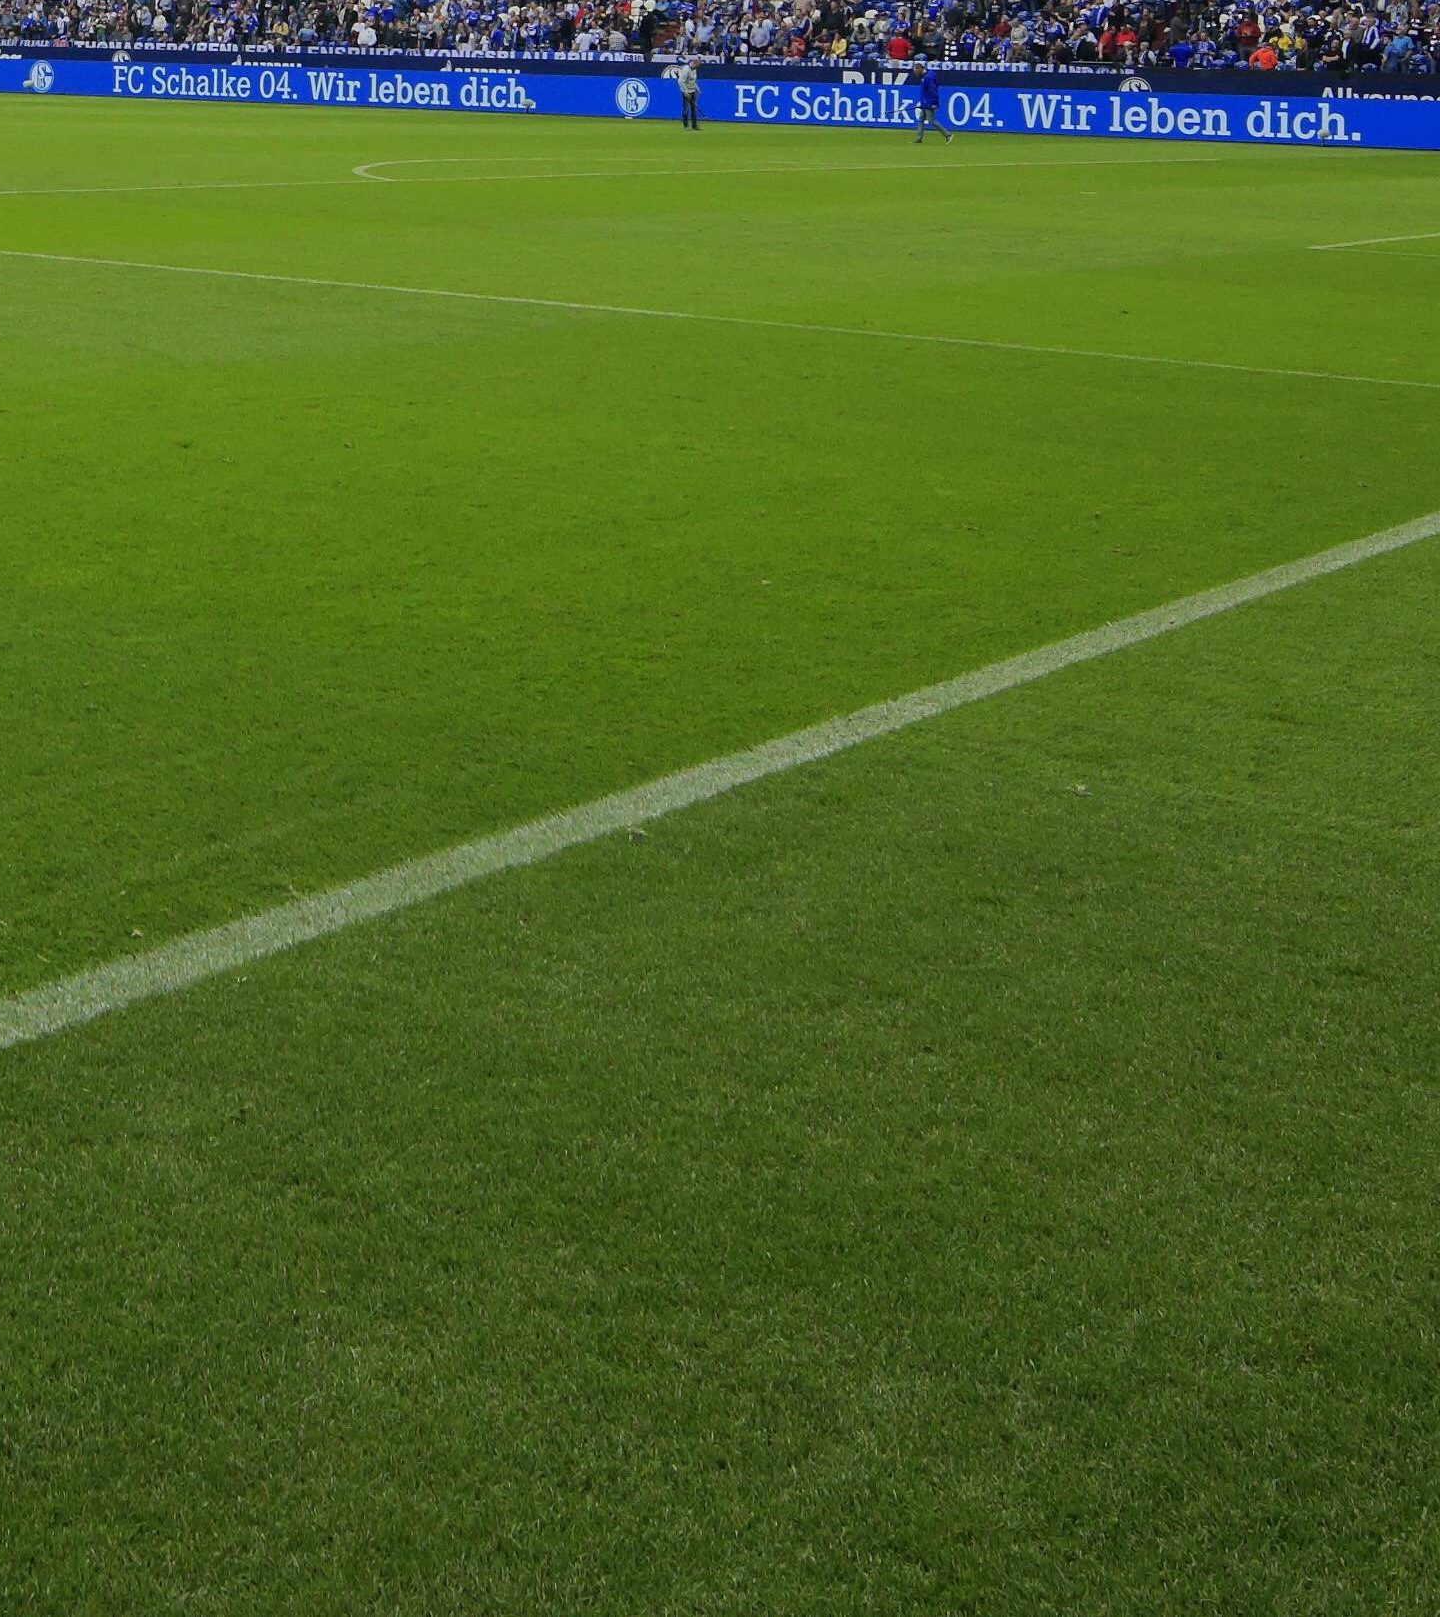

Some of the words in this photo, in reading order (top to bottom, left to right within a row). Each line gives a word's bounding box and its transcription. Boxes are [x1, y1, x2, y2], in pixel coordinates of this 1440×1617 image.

[113, 65, 144, 94] FC
[152, 67, 251, 98] Schalke
[259, 70, 298, 100] 04.
[307, 71, 360, 102] Wir
[369, 72, 449, 105] leben
[460, 73, 536, 109] dich.
[734, 84, 785, 119] FC
[948, 92, 1004, 129] 04.
[1018, 93, 1098, 133] Wir
[1109, 93, 1231, 137] leben
[1245, 98, 1362, 142] dich.
